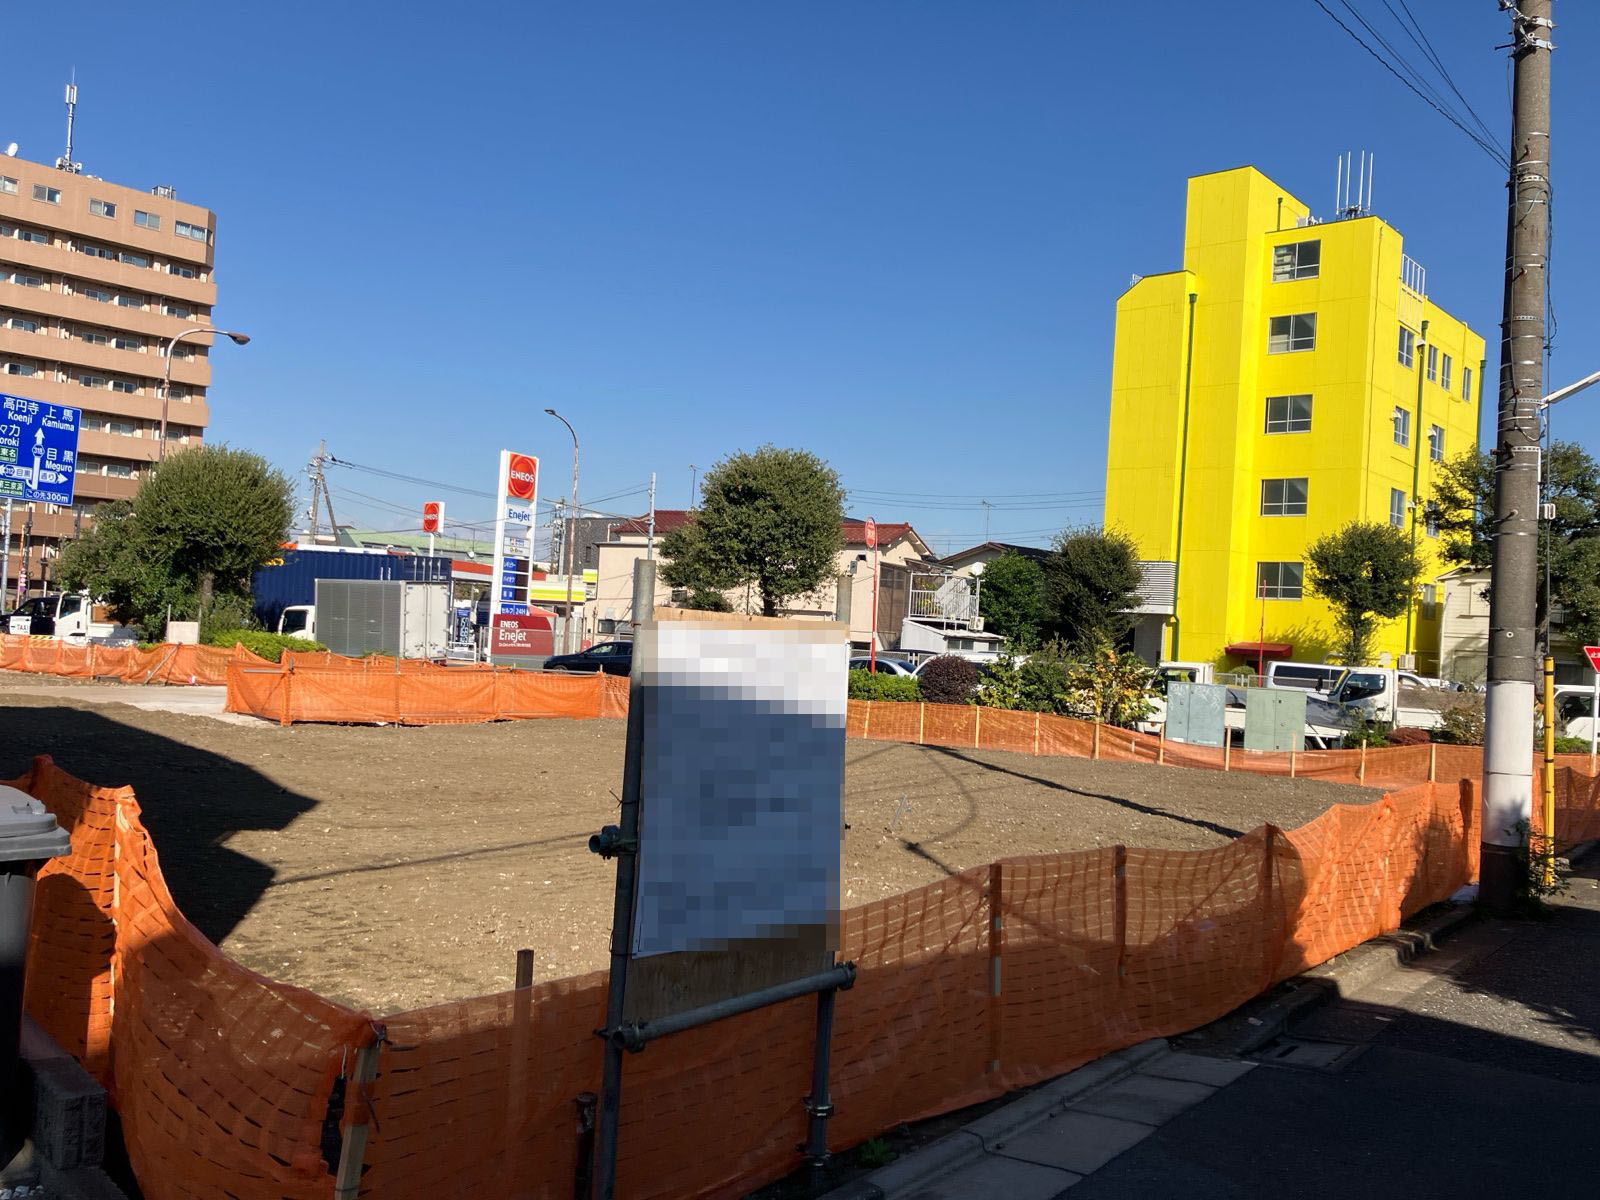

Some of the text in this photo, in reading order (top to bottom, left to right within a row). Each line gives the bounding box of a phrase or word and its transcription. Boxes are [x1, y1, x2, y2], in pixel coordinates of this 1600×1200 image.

[4, 397, 74, 421] 高円寺 上馬
[8, 410, 75, 432] Koenji Kamiuma
[47, 448, 74, 463] 目黒
[45, 460, 72, 472] Meguro
[511, 470, 535, 483] ENEOS
[508, 508, 531, 521] EneJet
[500, 620, 518, 628] ENEOS
[499, 629, 526, 643] EneJet
